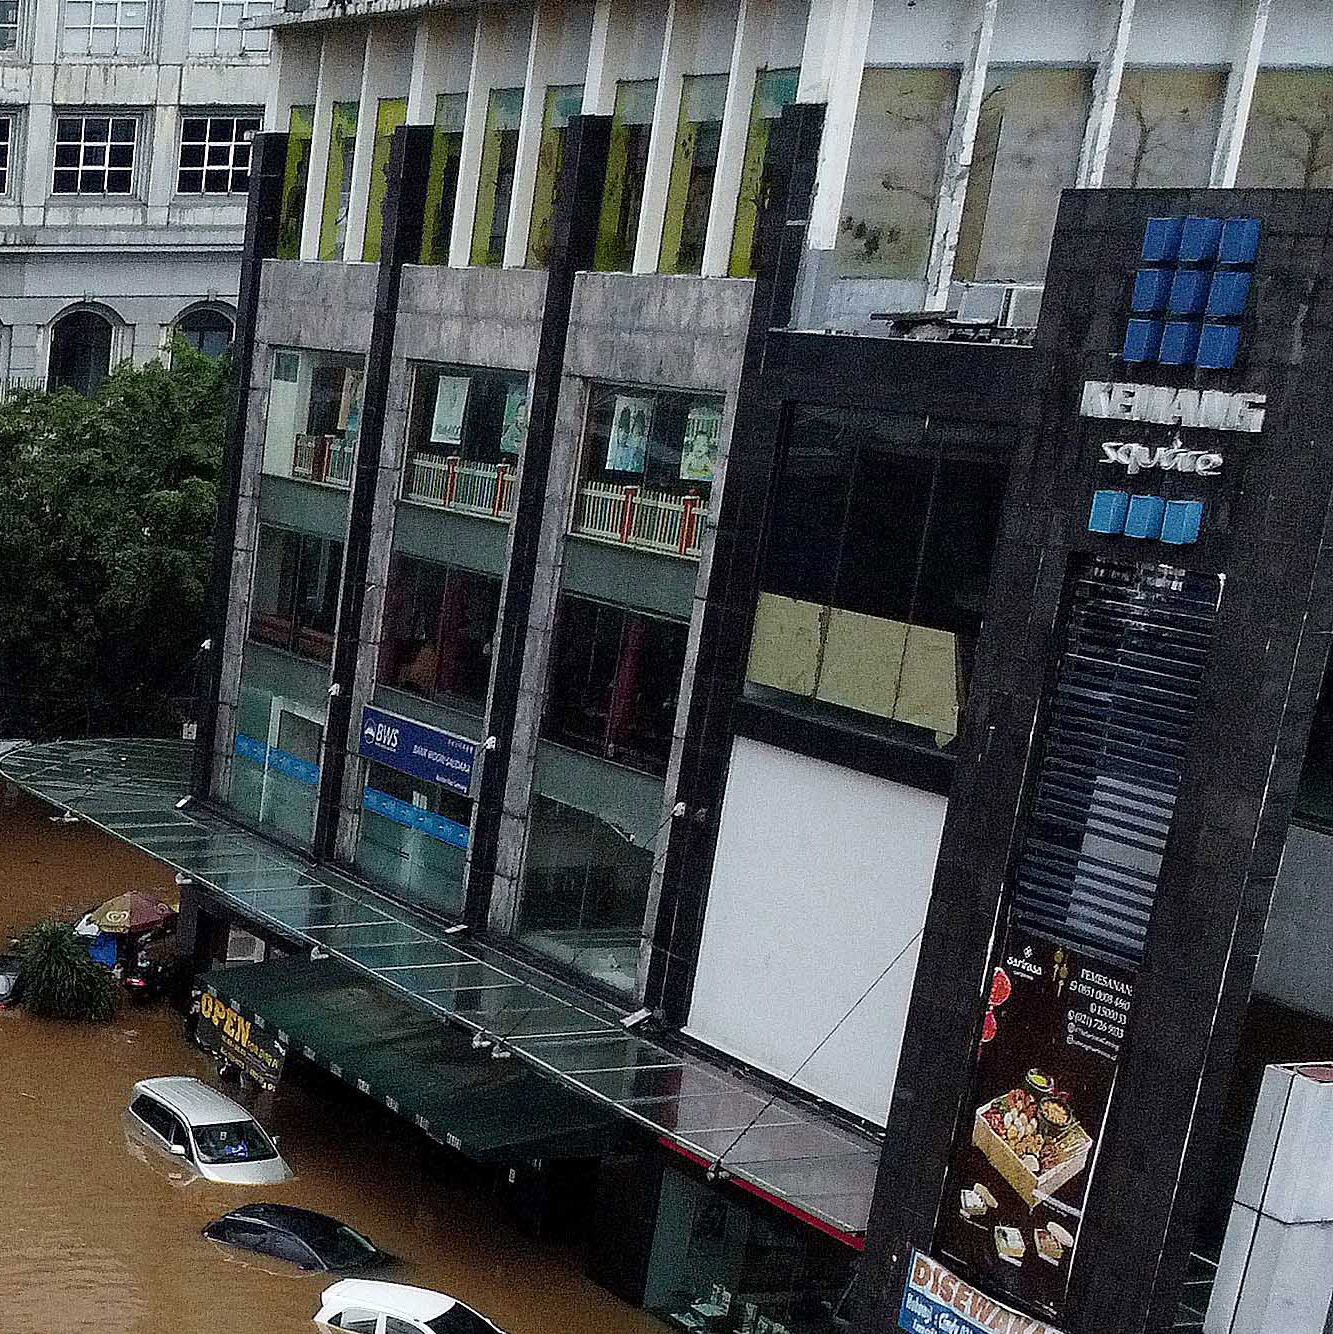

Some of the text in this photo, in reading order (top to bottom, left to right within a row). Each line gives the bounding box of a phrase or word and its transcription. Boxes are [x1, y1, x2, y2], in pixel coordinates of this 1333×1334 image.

[1079, 381, 1267, 432] KEMANG
[375, 723, 400, 748] BWS
[201, 991, 251, 1048] OPEN
